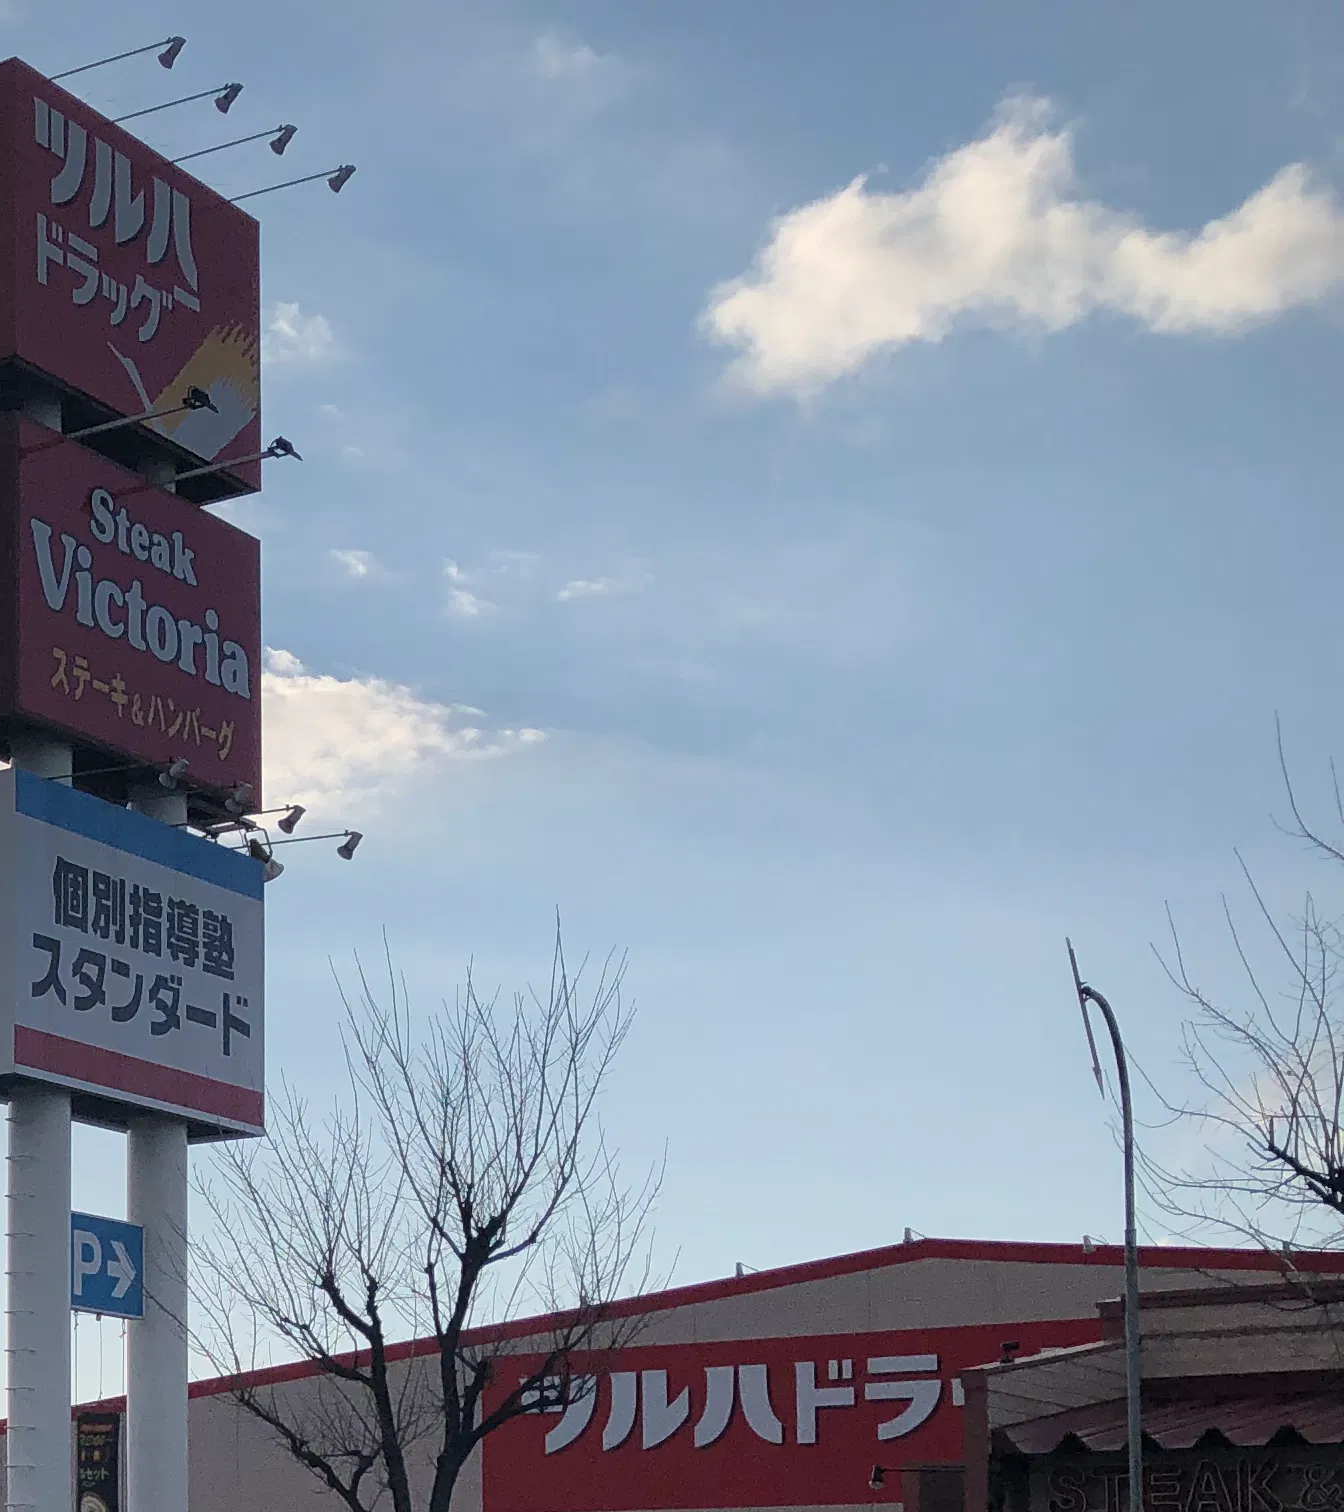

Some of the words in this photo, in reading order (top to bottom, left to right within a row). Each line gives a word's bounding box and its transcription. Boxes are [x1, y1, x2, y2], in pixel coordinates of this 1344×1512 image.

[33, 97, 199, 292] ツルハ
[90, 488, 198, 586] Steak
[30, 518, 251, 699] Victoria
[52, 855, 235, 981] 個別指導塾
[31, 932, 252, 1057] スタンダード
[73, 1230, 102, 1297] P
[519, 1353, 965, 1455] ツルハドラ
